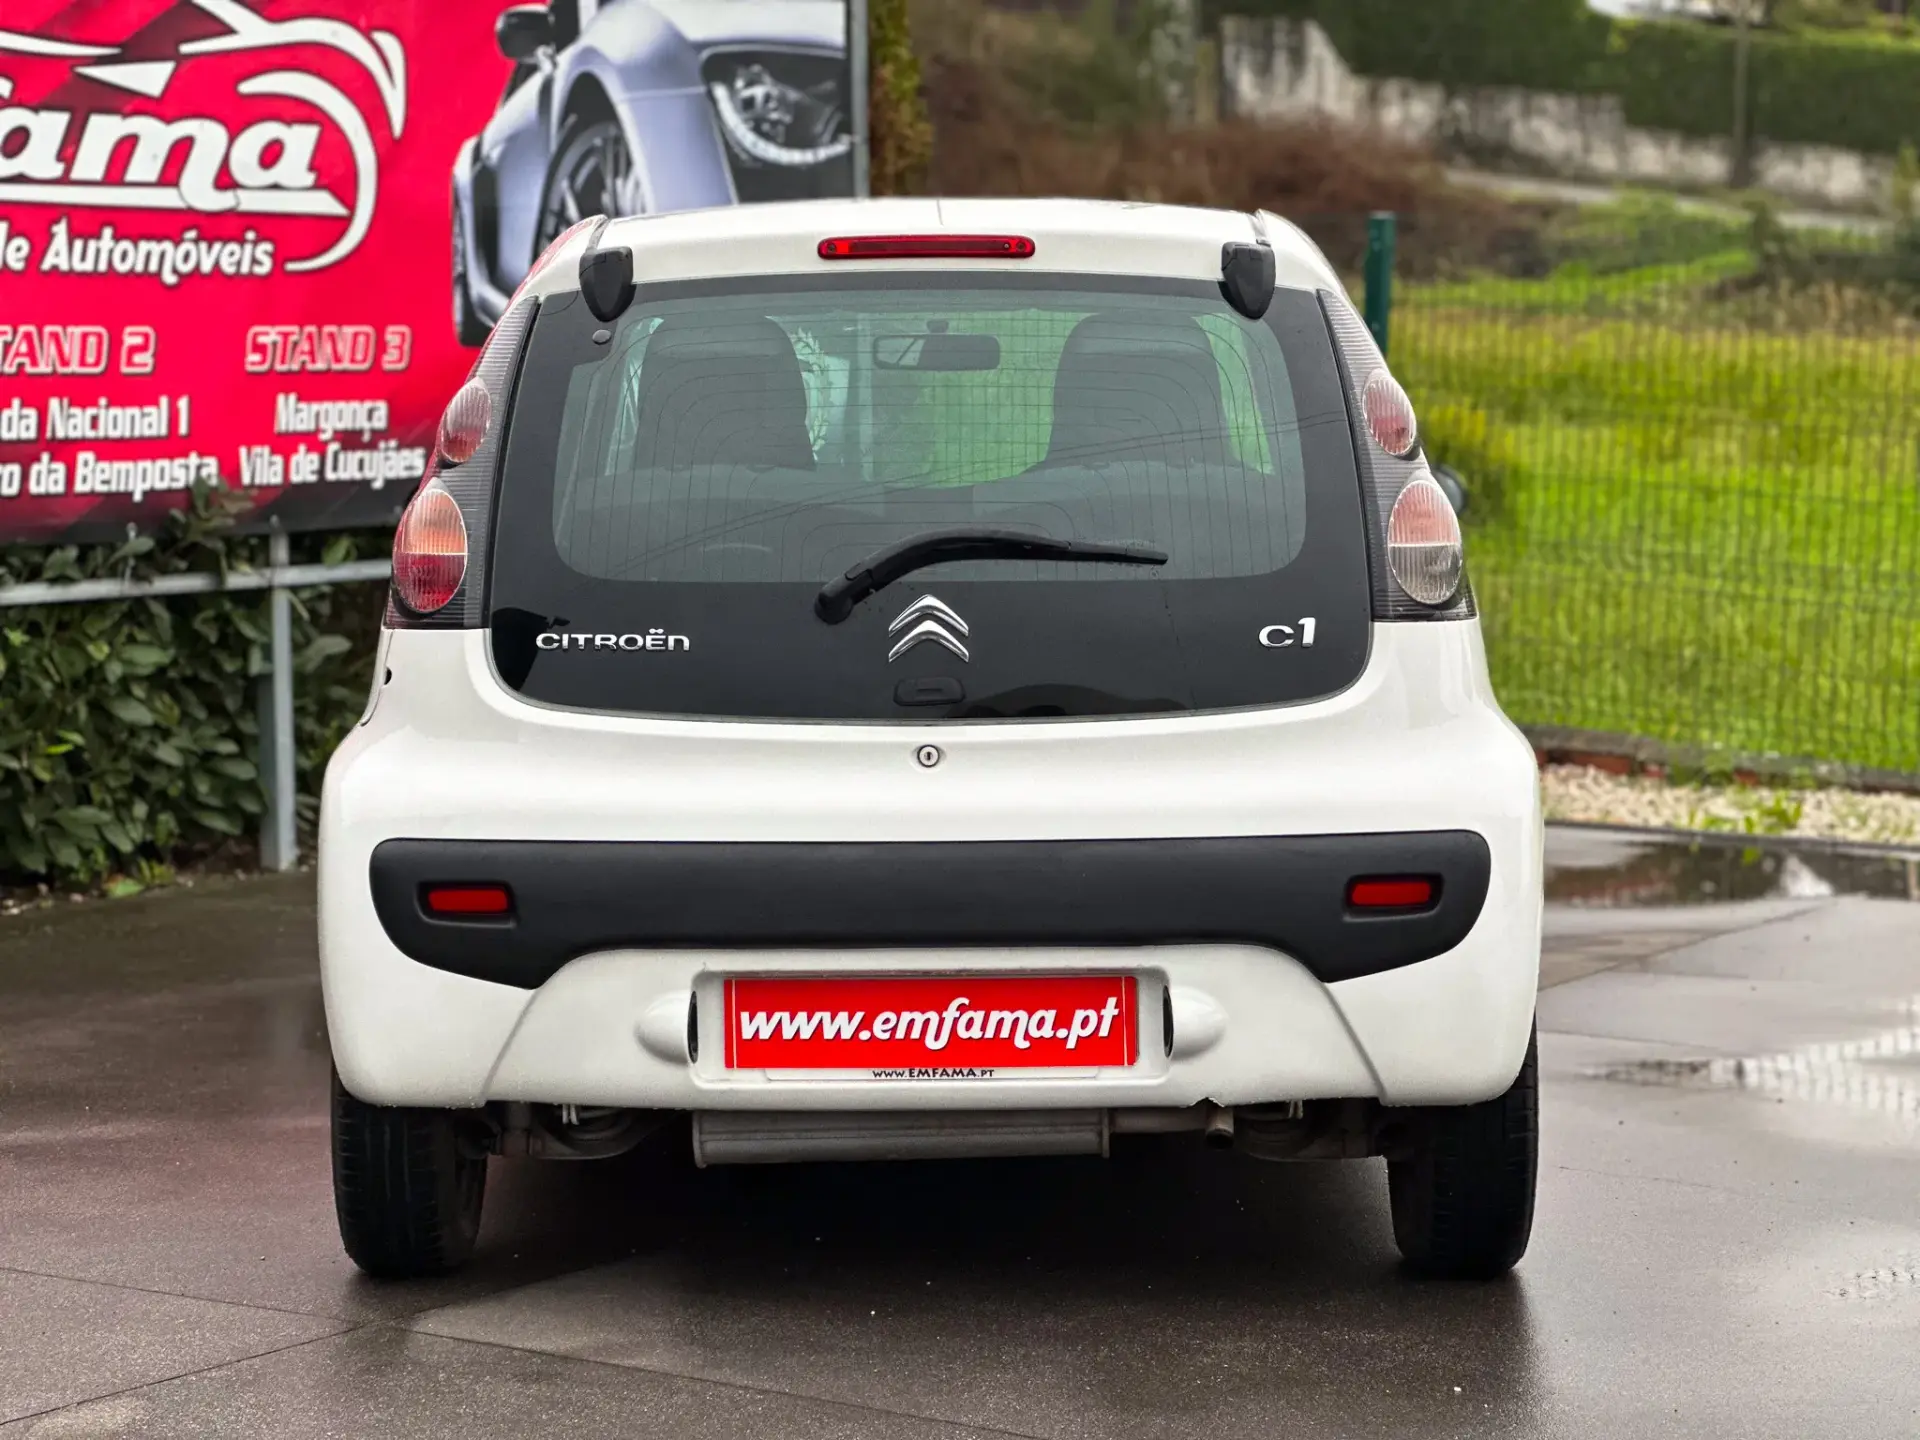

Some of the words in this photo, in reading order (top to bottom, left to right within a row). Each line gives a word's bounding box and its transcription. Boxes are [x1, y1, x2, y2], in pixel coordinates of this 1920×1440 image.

[0, 76, 322, 212] ama
[40, 216, 274, 285] Automóveis
[119, 324, 156, 374] 2
[245, 324, 376, 372] STAND
[381, 324, 412, 372] 3
[46, 394, 169, 440] Nacional
[176, 394, 190, 437] 1
[273, 392, 388, 442] Margonça
[29, 451, 67, 496] da
[74, 450, 218, 502] Bemposta
[239, 444, 284, 486] Vila
[289, 443, 321, 484] de
[324, 438, 426, 490] Cucujães
[740, 997, 1119, 1050] www.emfama.pt
